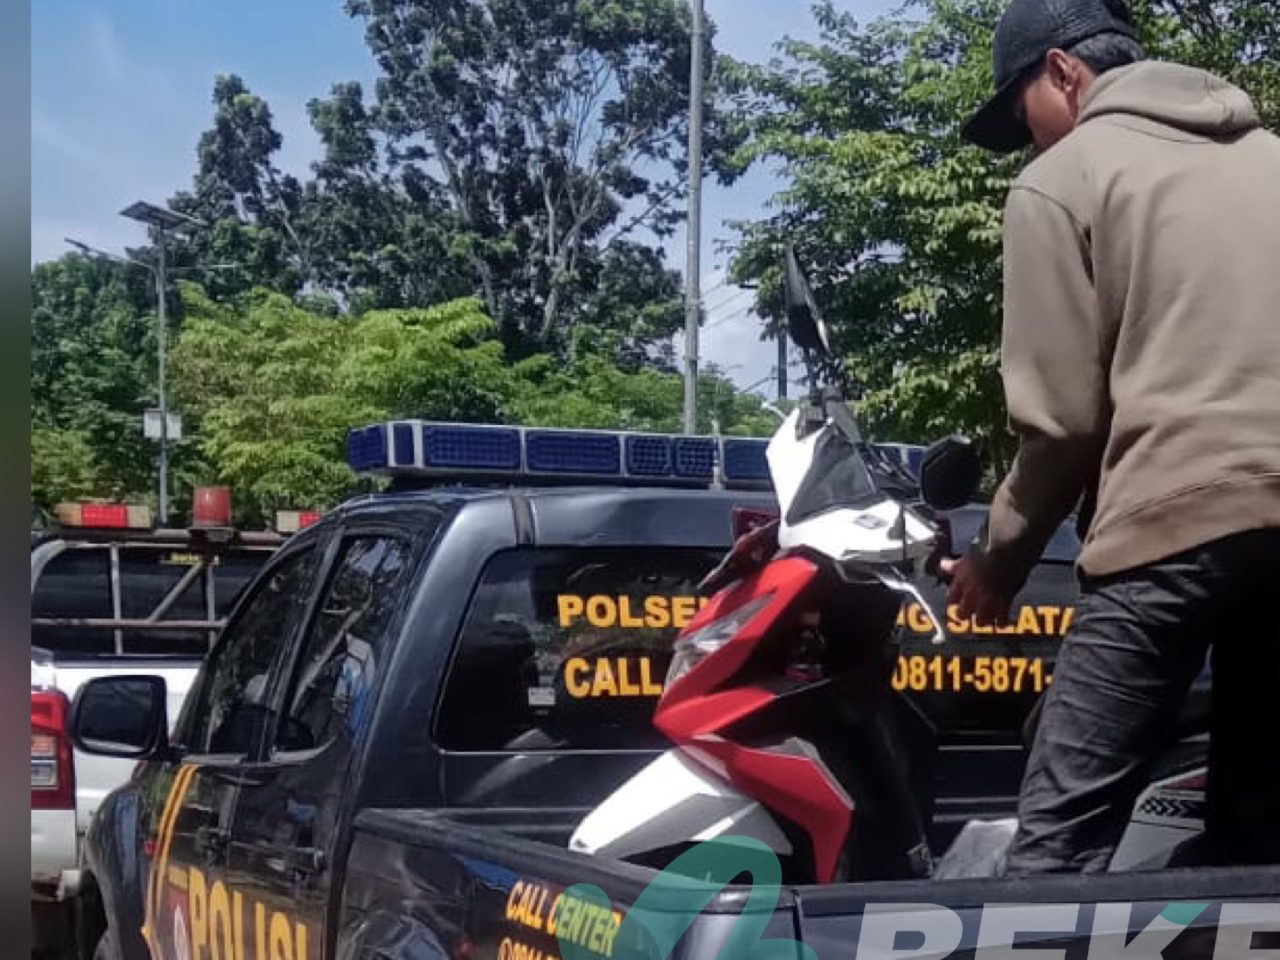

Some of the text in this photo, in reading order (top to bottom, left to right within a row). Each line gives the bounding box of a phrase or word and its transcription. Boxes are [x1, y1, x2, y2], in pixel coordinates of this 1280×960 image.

[558, 594, 709, 628] POLSE
[565, 657, 662, 698] CALL
[506, 880, 622, 957] CALL CENTER
